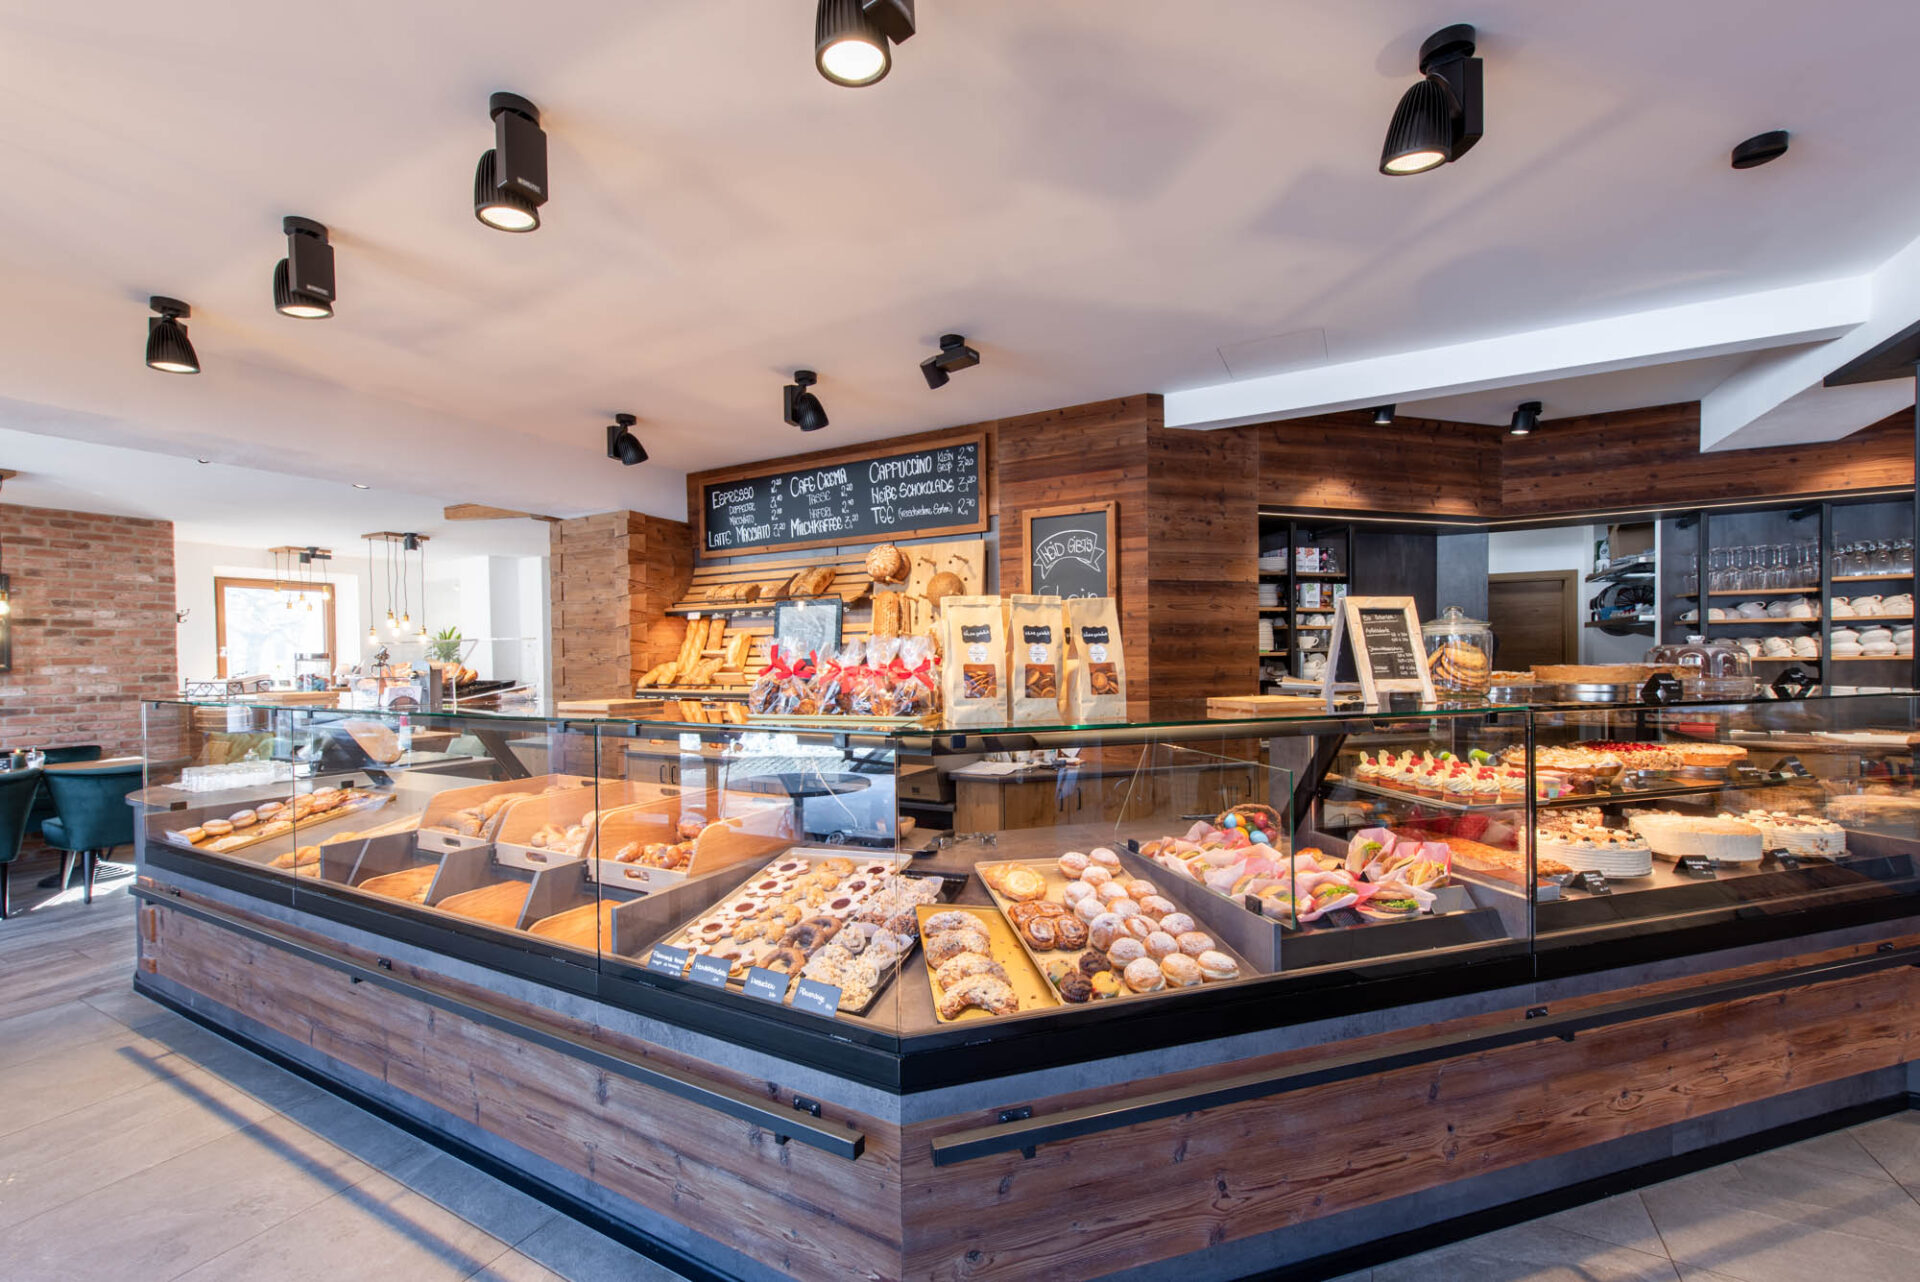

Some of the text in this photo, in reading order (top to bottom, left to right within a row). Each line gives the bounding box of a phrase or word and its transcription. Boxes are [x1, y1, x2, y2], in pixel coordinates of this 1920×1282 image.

[869, 455, 932, 483] CAPPUCCINO
[790, 467, 848, 497] CAFE CREMA
[899, 478, 955, 498] SCHOKOLADE
[712, 486, 754, 509] ESPRESSO
[870, 505, 895, 524] TEE
[708, 530, 732, 547] LATTE
